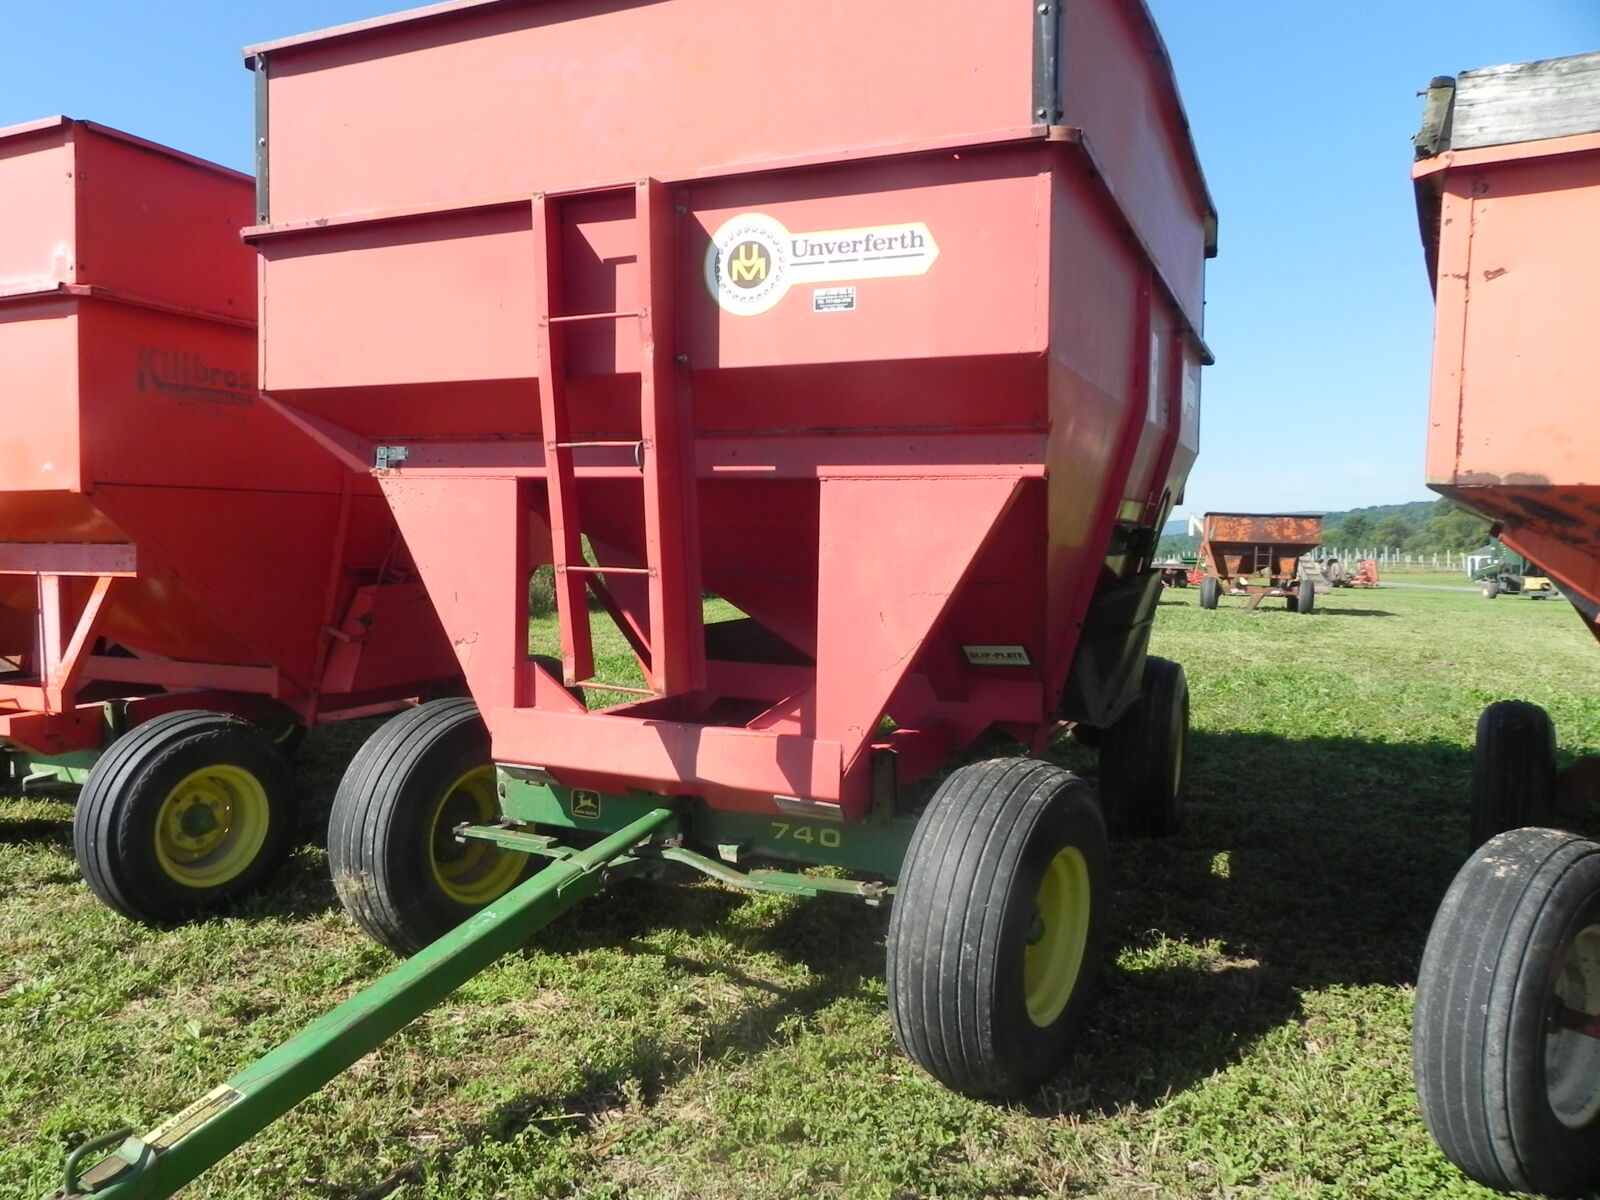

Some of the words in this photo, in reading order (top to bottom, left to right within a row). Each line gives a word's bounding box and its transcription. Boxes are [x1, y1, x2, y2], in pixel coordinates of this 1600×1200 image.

[790, 230, 925, 258] Unverferth
[771, 822, 840, 847] 740
[170, 1096, 213, 1126] CAUTION
